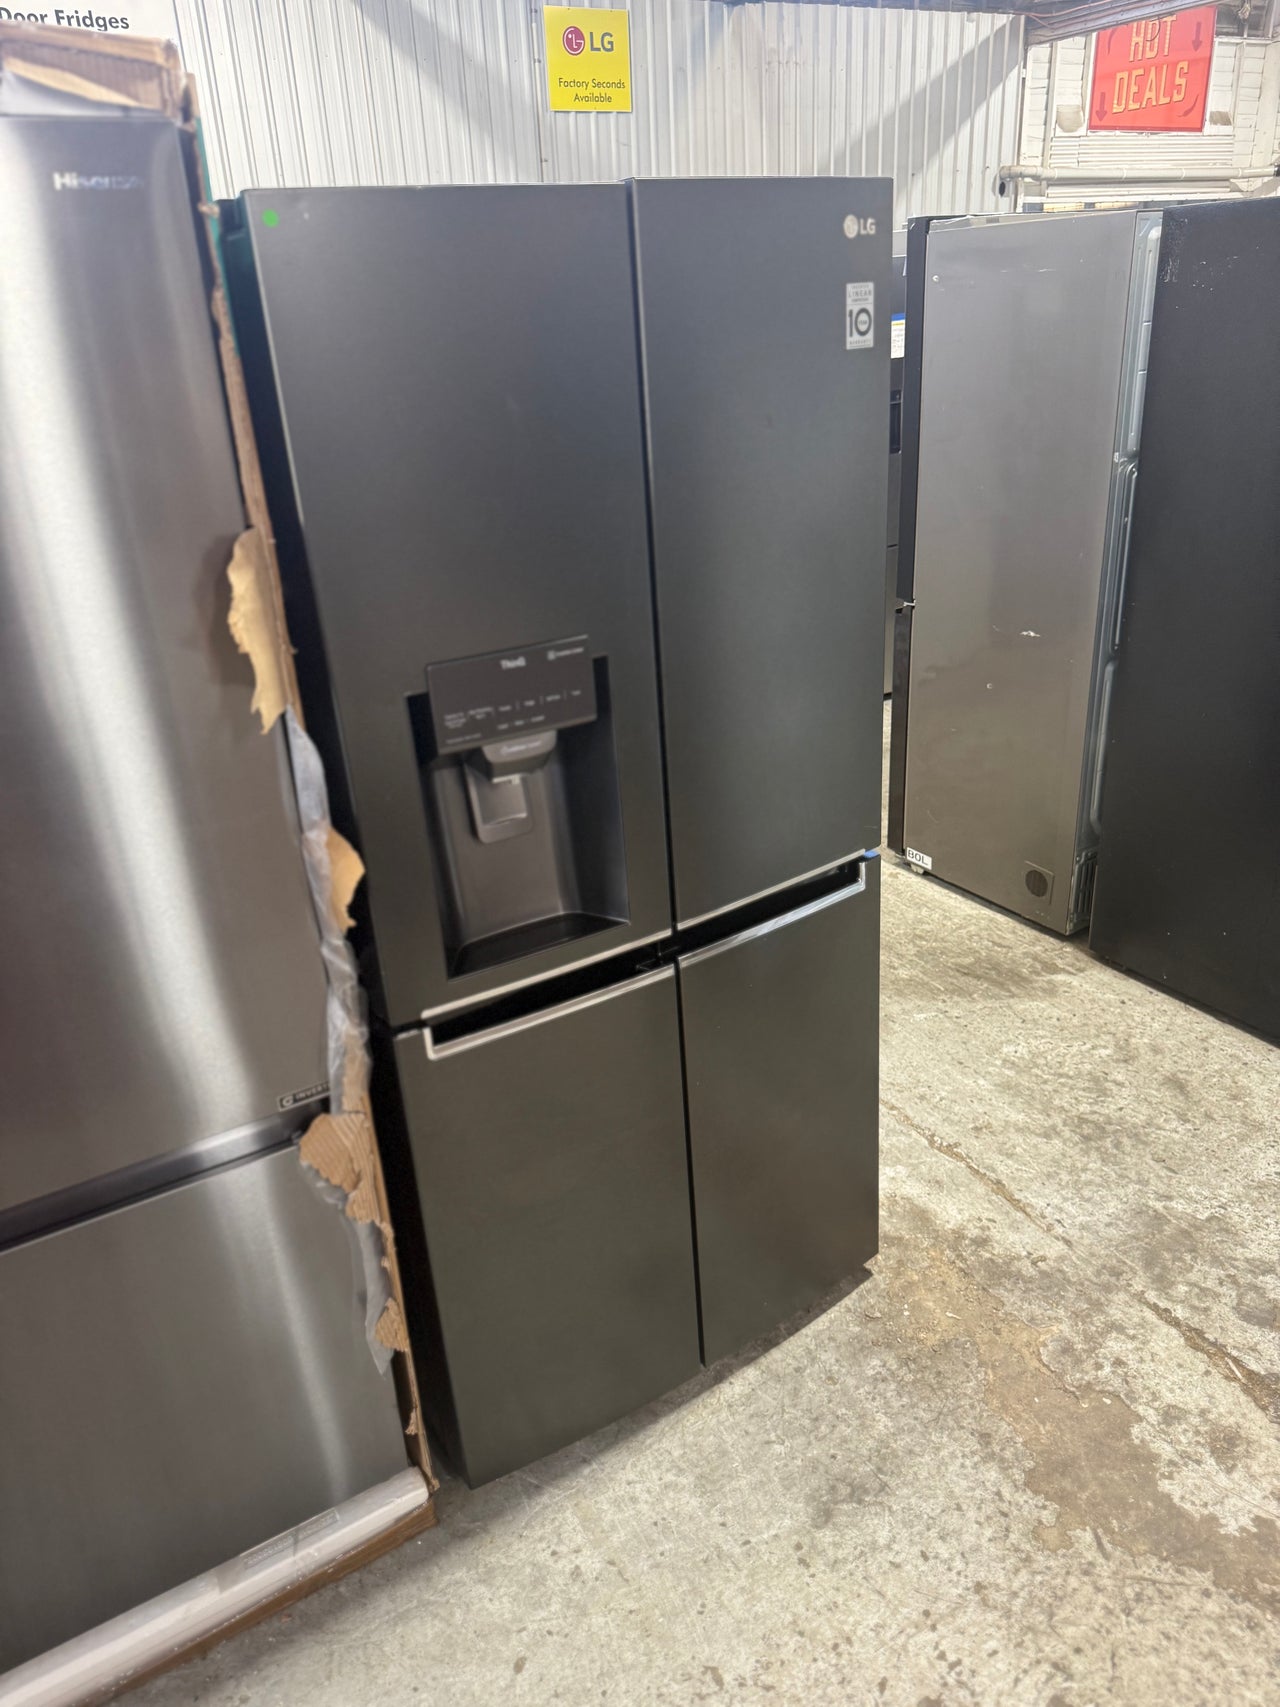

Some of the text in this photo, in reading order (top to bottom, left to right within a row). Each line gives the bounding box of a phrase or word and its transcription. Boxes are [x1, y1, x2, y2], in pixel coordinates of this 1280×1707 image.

[0, 7, 130, 31] Door Fridges
[589, 31, 615, 52] LG
[1128, 15, 1177, 63] HOT
[558, 77, 626, 91] Factory Seconds
[1111, 60, 1189, 115] DEALS
[573, 92, 613, 103] Available
[860, 217, 876, 235] LG
[848, 307, 872, 338] 10
